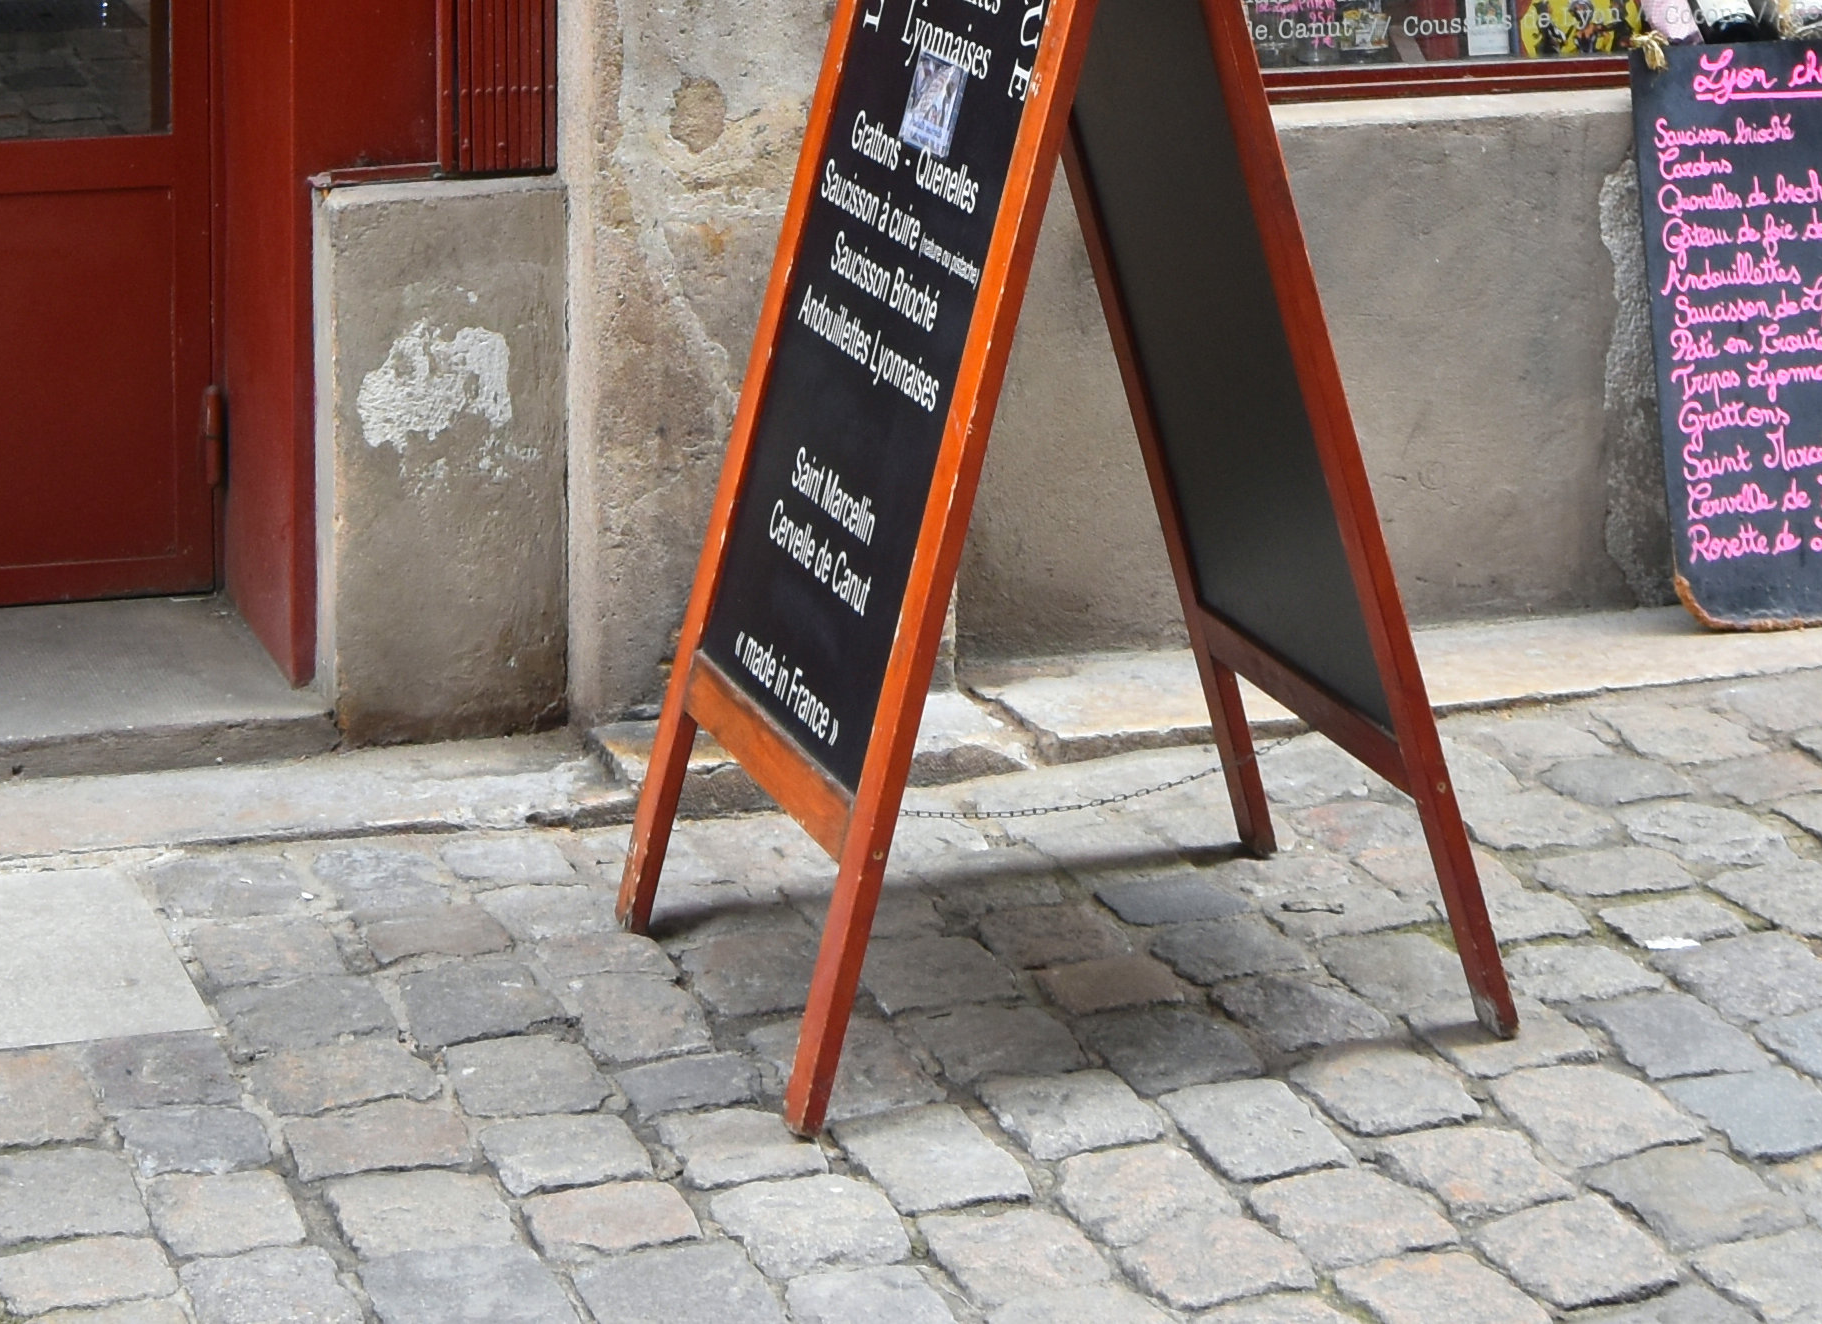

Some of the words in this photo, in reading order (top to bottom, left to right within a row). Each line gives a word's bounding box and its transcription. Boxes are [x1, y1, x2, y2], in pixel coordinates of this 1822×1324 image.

[1278, 17, 1352, 40] Canut
[1694, 49, 1777, 104] Lyon
[851, 110, 901, 171] Grattons
[916, 147, 979, 214] Quenelles
[821, 159, 879, 228] Saucisson
[878, 192, 887, 233] à
[888, 204, 921, 251] cuire
[1747, 175, 1769, 209] de
[1737, 213, 1760, 244] de
[830, 231, 888, 302] Saucisson
[888, 266, 940, 333] Brioché
[1661, 251, 1802, 296] Andouillettes
[1774, 289, 1799, 319] de
[798, 284, 872, 365] Andouillettes
[869, 330, 939, 413] Lyonnaises
[1723, 335, 1754, 353] en
[1671, 363, 1740, 408] Tripes
[1678, 401, 1791, 451] Grattons
[1683, 444, 1752, 481] Saint
[792, 446, 824, 504] Saint
[821, 469, 876, 547] Marcellin
[1782, 478, 1811, 512] de
[769, 499, 815, 570] Cervelle
[814, 539, 831, 584] de
[832, 551, 872, 617] Canut
[1688, 523, 1769, 564] Rosette
[1772, 520, 1802, 555] de
[742, 635, 775, 688] made
[774, 655, 789, 698] in
[787, 667, 829, 740] France
